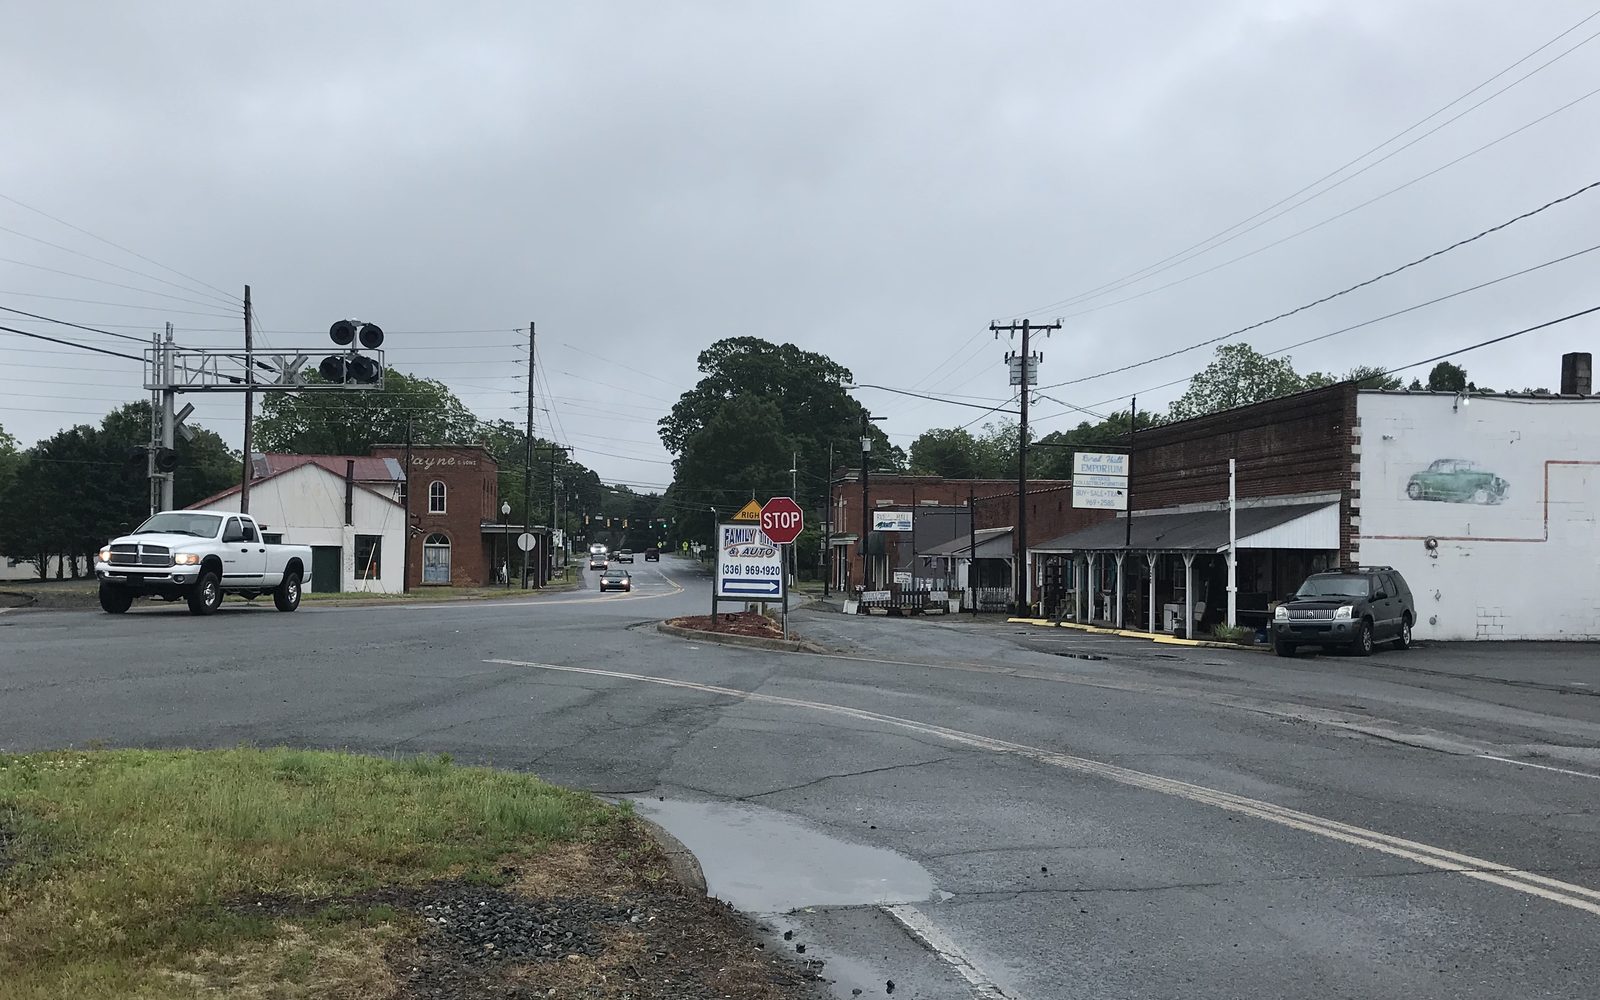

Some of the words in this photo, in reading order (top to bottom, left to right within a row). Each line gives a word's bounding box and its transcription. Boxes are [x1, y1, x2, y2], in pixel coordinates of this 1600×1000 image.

[410, 454, 456, 470] ayne
[1081, 464, 1123, 474] EMPORIUM
[763, 511, 800, 529] STOP
[724, 528, 757, 549] FAMILY
[729, 547, 738, 556] &
[742, 547, 775, 557] AUTO
[722, 564, 742, 575] (336)
[745, 565, 780, 576] 969-1920
